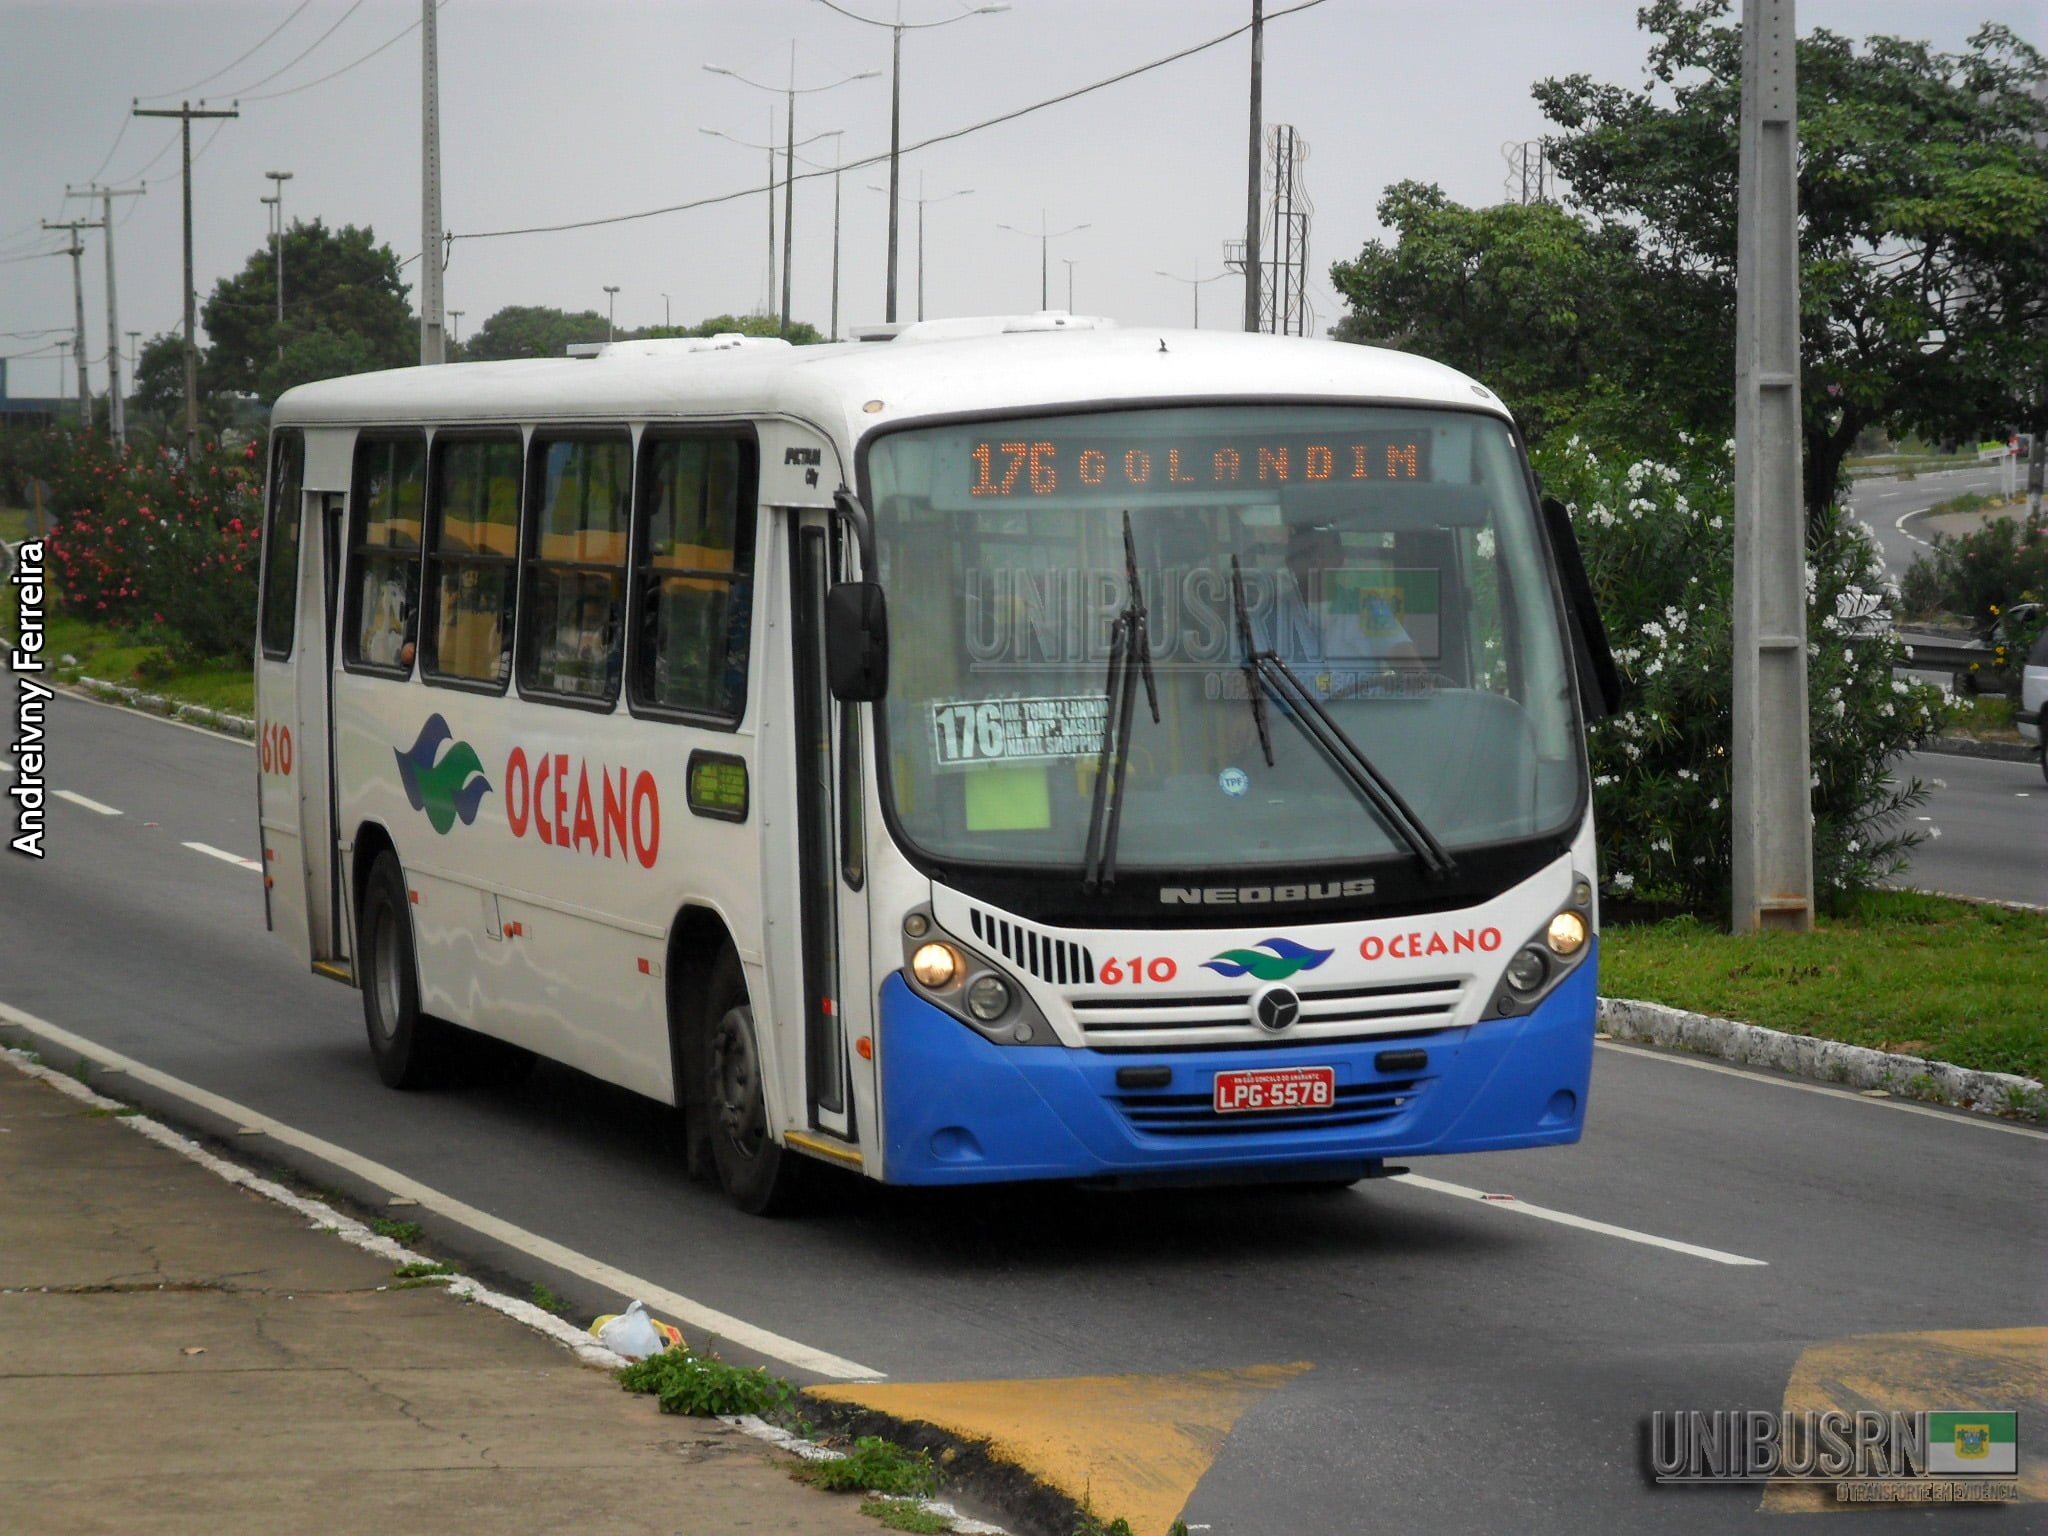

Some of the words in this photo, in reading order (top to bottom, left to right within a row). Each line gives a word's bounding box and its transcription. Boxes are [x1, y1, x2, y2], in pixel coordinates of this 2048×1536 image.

[970, 441, 1056, 496] 176
[1078, 444, 1417, 485] GOLANDIM
[261, 717, 292, 777] 610
[936, 703, 1003, 760] 176
[1007, 737, 1045, 755] NATAL
[505, 746, 660, 869] OCEANO
[1160, 878, 1375, 904] NEOBUS
[1359, 927, 1502, 962] OCEANO
[1099, 956, 1177, 985] 610
